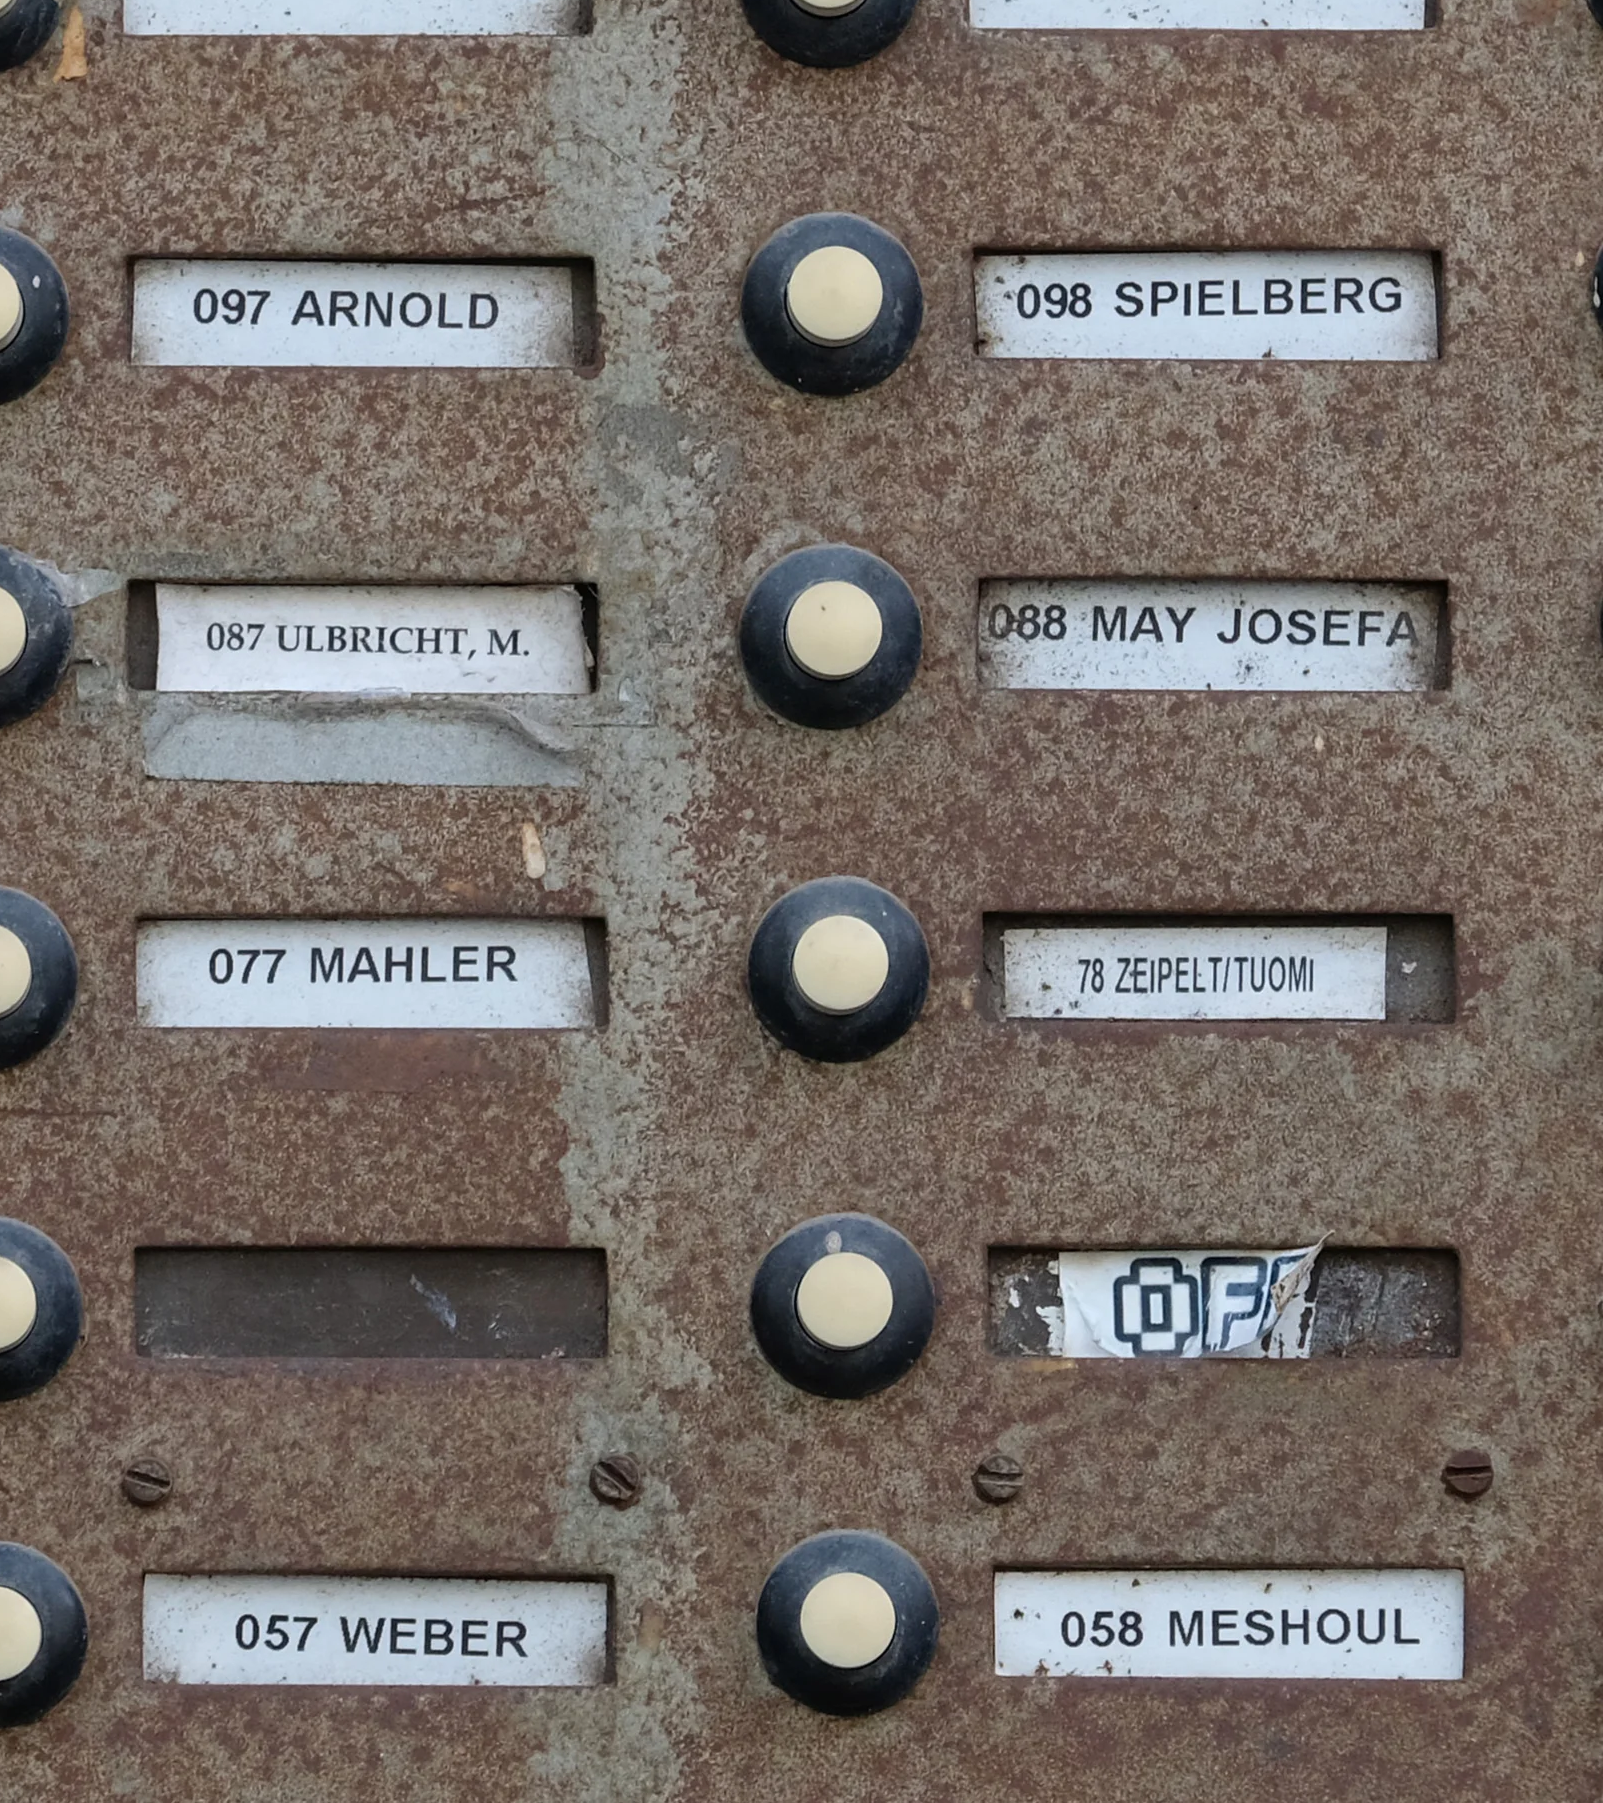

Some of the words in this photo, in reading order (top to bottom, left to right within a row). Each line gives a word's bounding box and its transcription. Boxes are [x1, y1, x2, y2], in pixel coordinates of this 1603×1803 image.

[193, 288, 271, 325] 097
[291, 289, 499, 330] ARNOLD
[1016, 282, 1093, 319] 098
[1114, 276, 1402, 318] SPIELBERG
[206, 622, 266, 651] 087
[275, 624, 477, 661] ULBRICHT,
[487, 628, 530, 657] M.
[986, 603, 1066, 647] 088
[1092, 605, 1197, 643] MAY
[1218, 603, 1417, 647] JOSEFA
[209, 948, 287, 985] 077
[310, 945, 518, 984] MAHLER
[1077, 957, 1105, 994] 78
[1114, 955, 1314, 994] ZEIPELT/TUOMI
[235, 1613, 318, 1652] 057
[339, 1616, 528, 1658] WEBER
[1060, 1610, 1144, 1648] 058
[1169, 1608, 1421, 1647] MESHOUL
